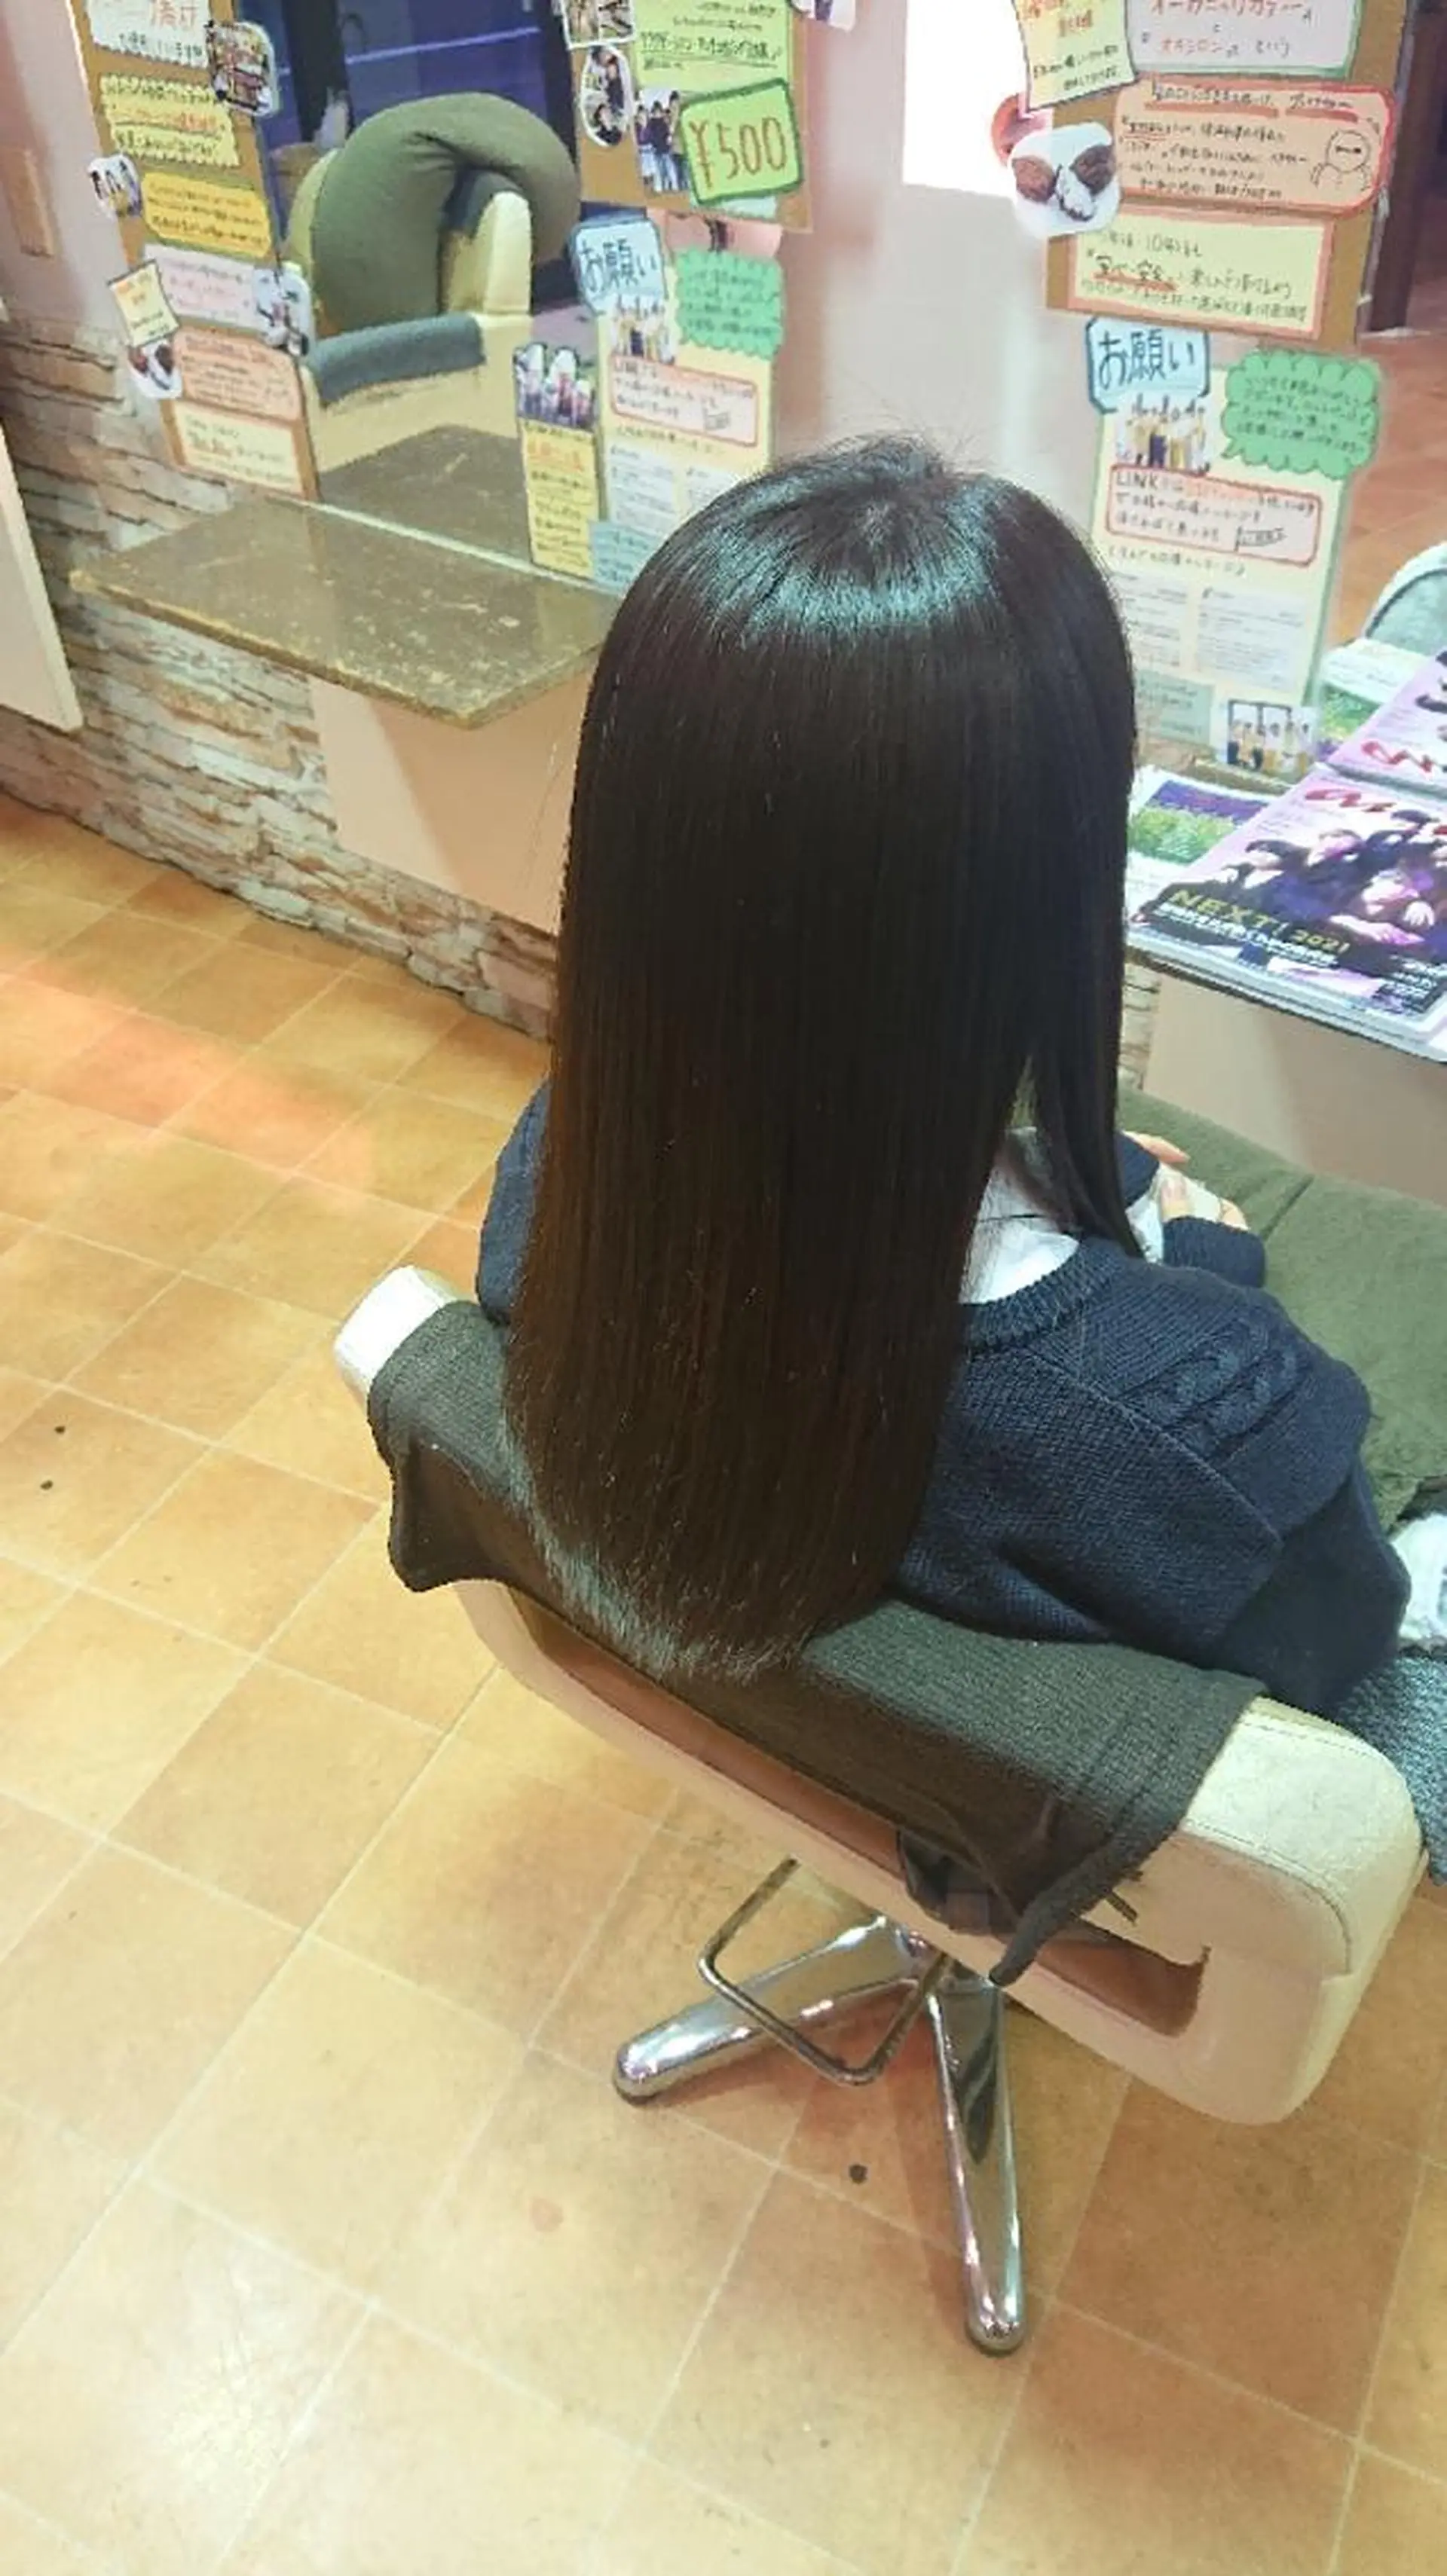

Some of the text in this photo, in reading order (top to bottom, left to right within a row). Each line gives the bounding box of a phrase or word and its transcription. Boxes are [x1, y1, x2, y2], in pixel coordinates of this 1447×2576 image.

[688, 115, 789, 190] ¥500
[578, 237, 659, 292] お願い
[1098, 328, 1195, 390] お願い
[1167, 889, 1289, 937] NEXT!
[1292, 928, 1351, 955] 2021
